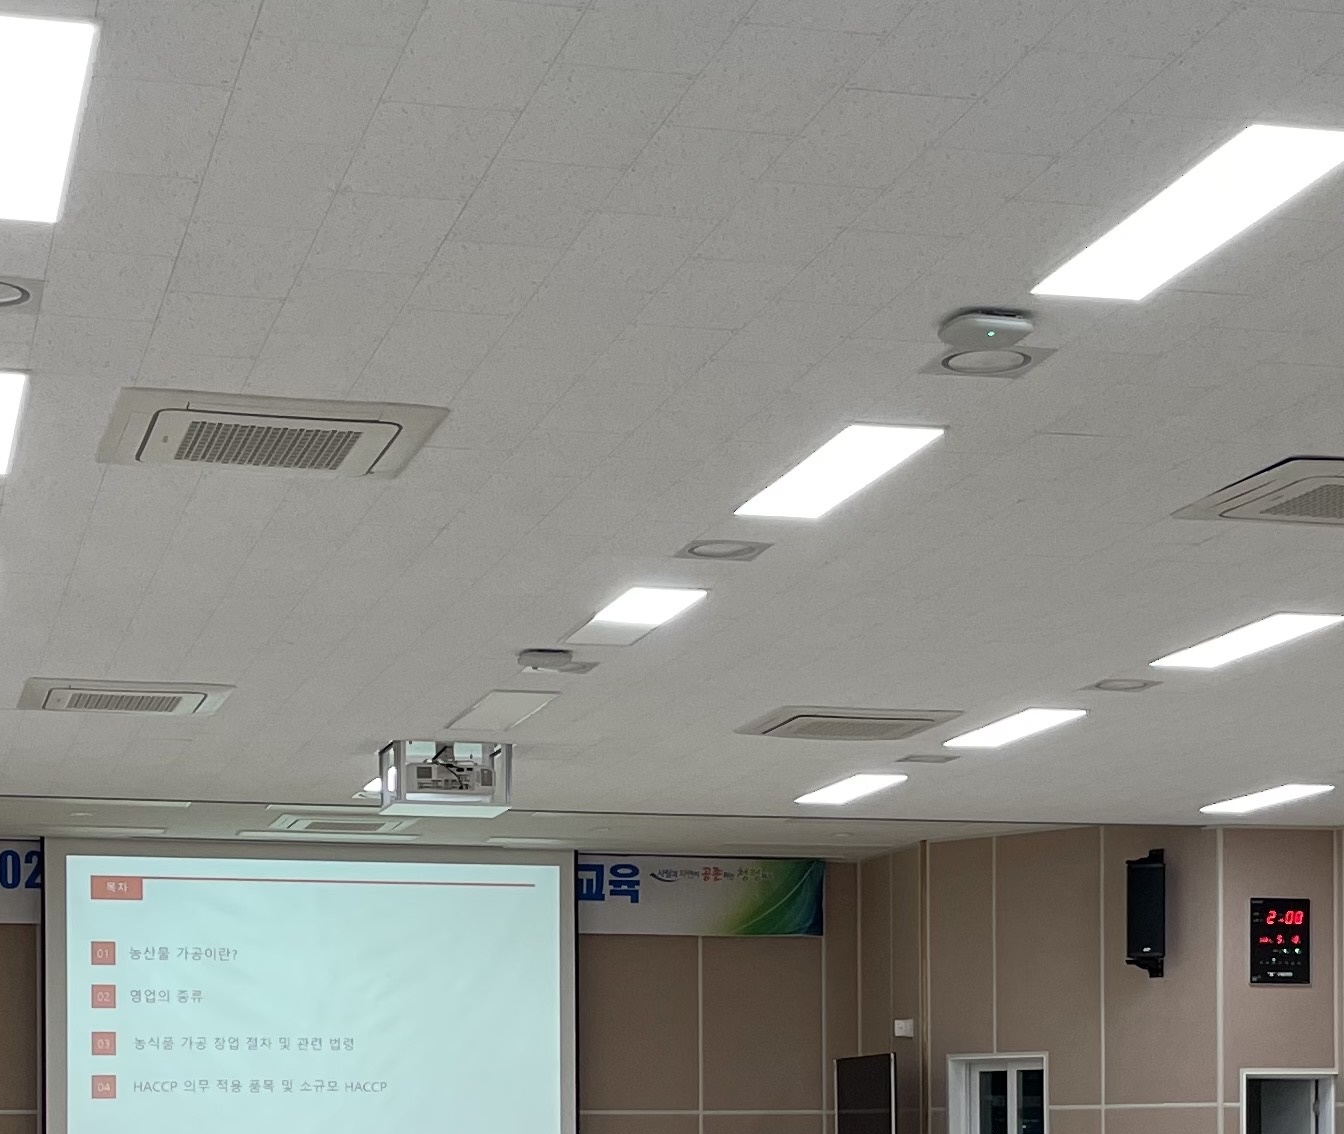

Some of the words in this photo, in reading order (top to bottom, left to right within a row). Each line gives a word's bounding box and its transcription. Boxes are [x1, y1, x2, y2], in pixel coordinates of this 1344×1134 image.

[96, 948, 110, 960] 01
[129, 946, 171, 962] 농산물
[176, 947, 238, 962] 가공이란?
[96, 991, 111, 1003] 02
[129, 989, 171, 1004] 영업의
[176, 989, 204, 1004] 종류
[97, 1038, 111, 1050] 03
[133, 1036, 175, 1051] 농식품
[180, 1036, 207, 1051] 가공
[213, 1036, 240, 1051] 창업
[245, 1036, 273, 1051] 절차
[278, 1036, 292, 1052] 및
[297, 1036, 324, 1052] 관련
[329, 1036, 355, 1052] 법령
[133, 1080, 178, 1094] HACCP
[183, 1079, 211, 1094] 의무
[216, 1079, 243, 1094] 적용
[248, 1079, 275, 1094] 품목
[280, 1079, 295, 1094] 및
[299, 1079, 340, 1094] 소규모
[344, 1080, 388, 1094] HACCP
